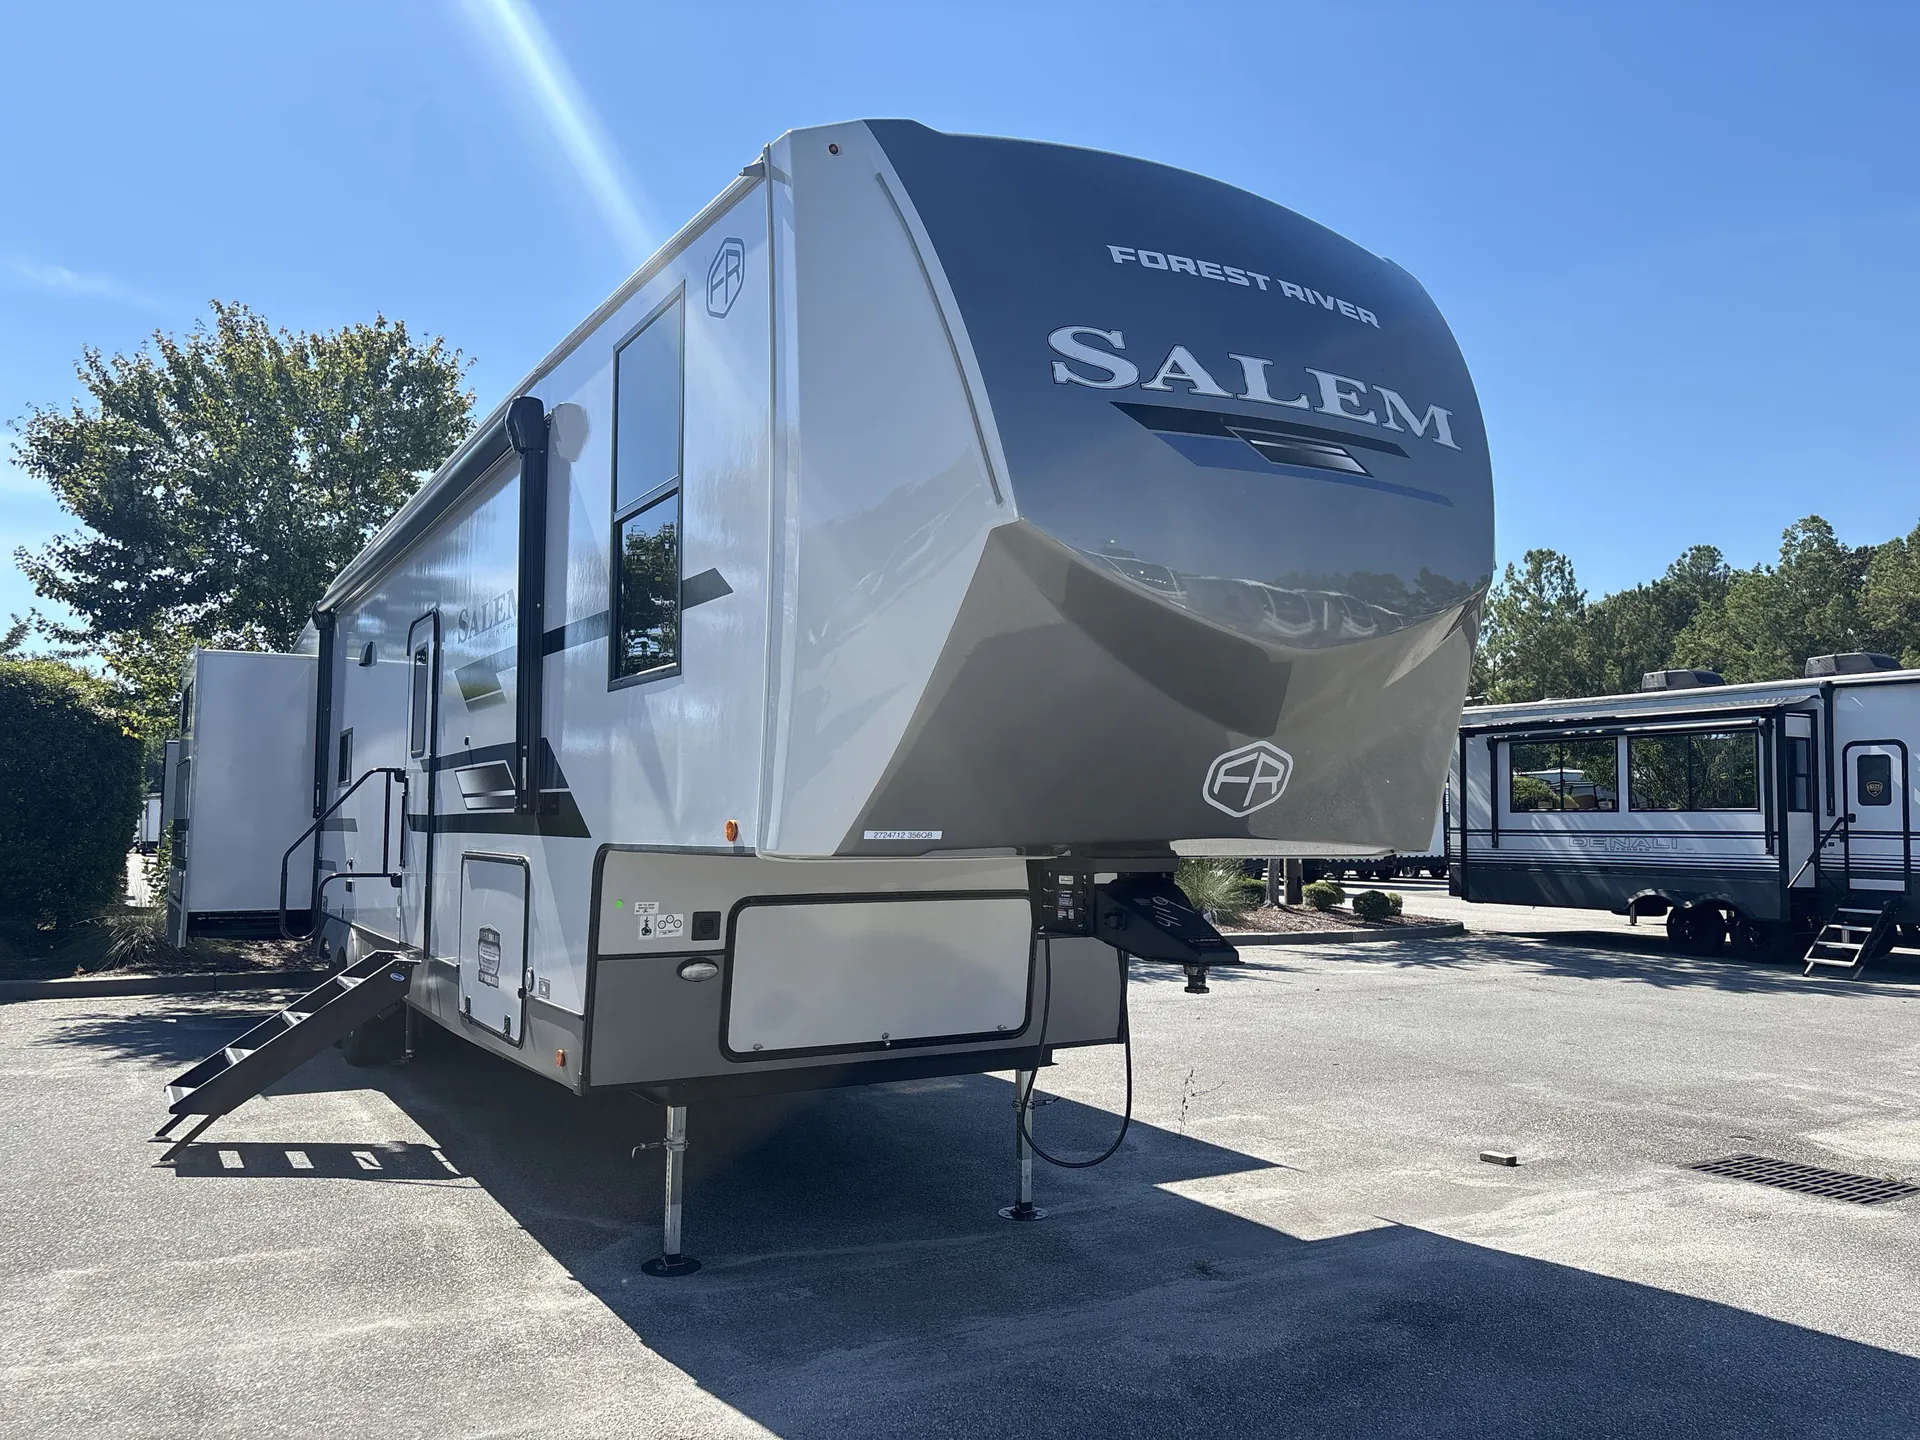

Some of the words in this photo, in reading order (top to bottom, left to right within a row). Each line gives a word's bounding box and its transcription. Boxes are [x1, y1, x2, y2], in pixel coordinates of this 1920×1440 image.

[1106, 245, 1270, 291] FOREST
[1277, 279, 1381, 329] RIVER
[1047, 325, 1463, 452] SALEM
[1569, 837, 1678, 850] DENALI
